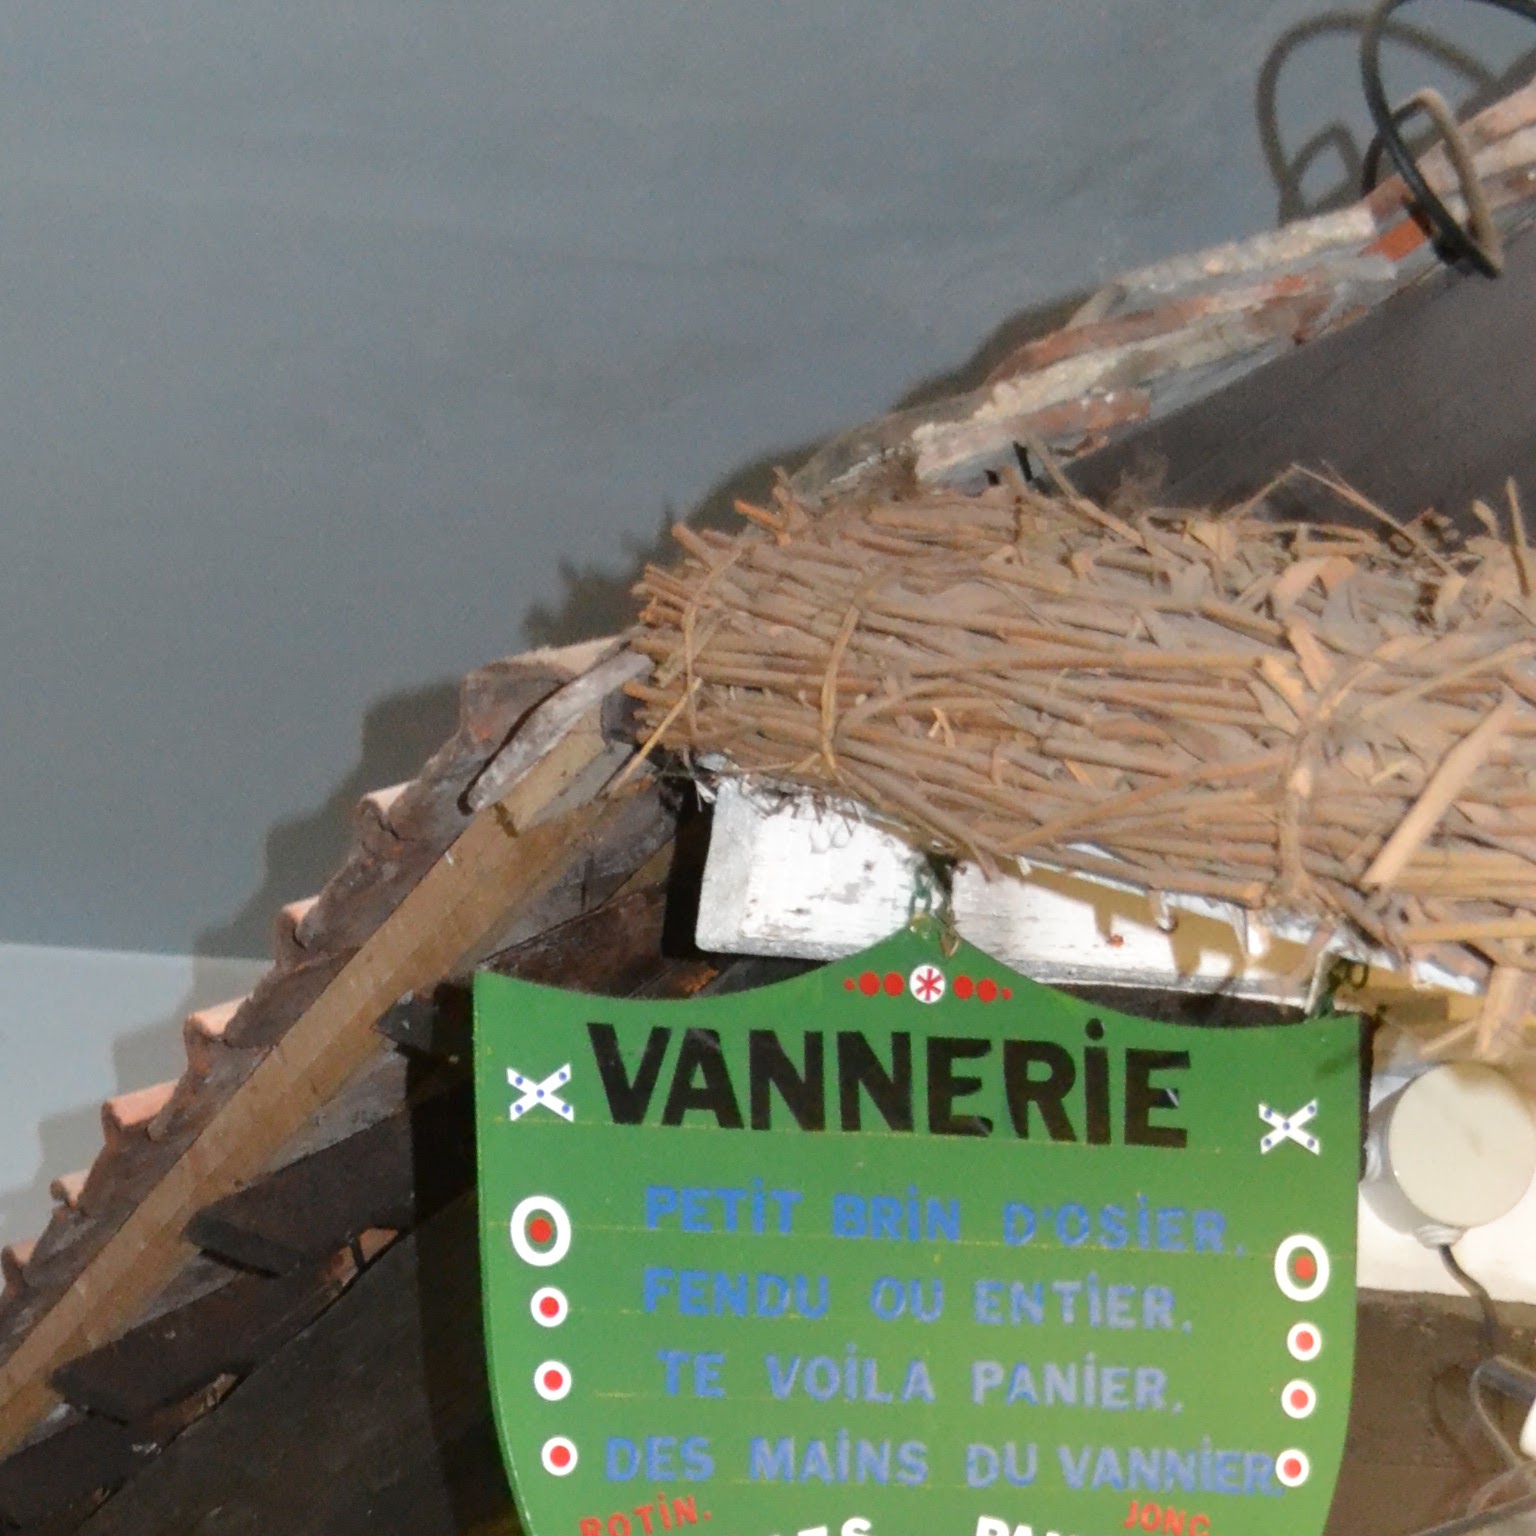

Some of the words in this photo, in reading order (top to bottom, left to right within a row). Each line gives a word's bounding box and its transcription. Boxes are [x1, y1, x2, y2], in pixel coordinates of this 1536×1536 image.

[587, 1018, 1192, 1149] VANNERIE
[644, 1176, 802, 1235] PETIT
[831, 1182, 961, 1243] BRIN
[644, 1266, 830, 1321] FENDU
[870, 1277, 944, 1324] OU
[657, 1351, 725, 1398] TE
[767, 1343, 933, 1403] VOILA
[604, 1436, 715, 1484] DES
[748, 1428, 929, 1485] MAINS
[967, 1443, 1039, 1488] DU
